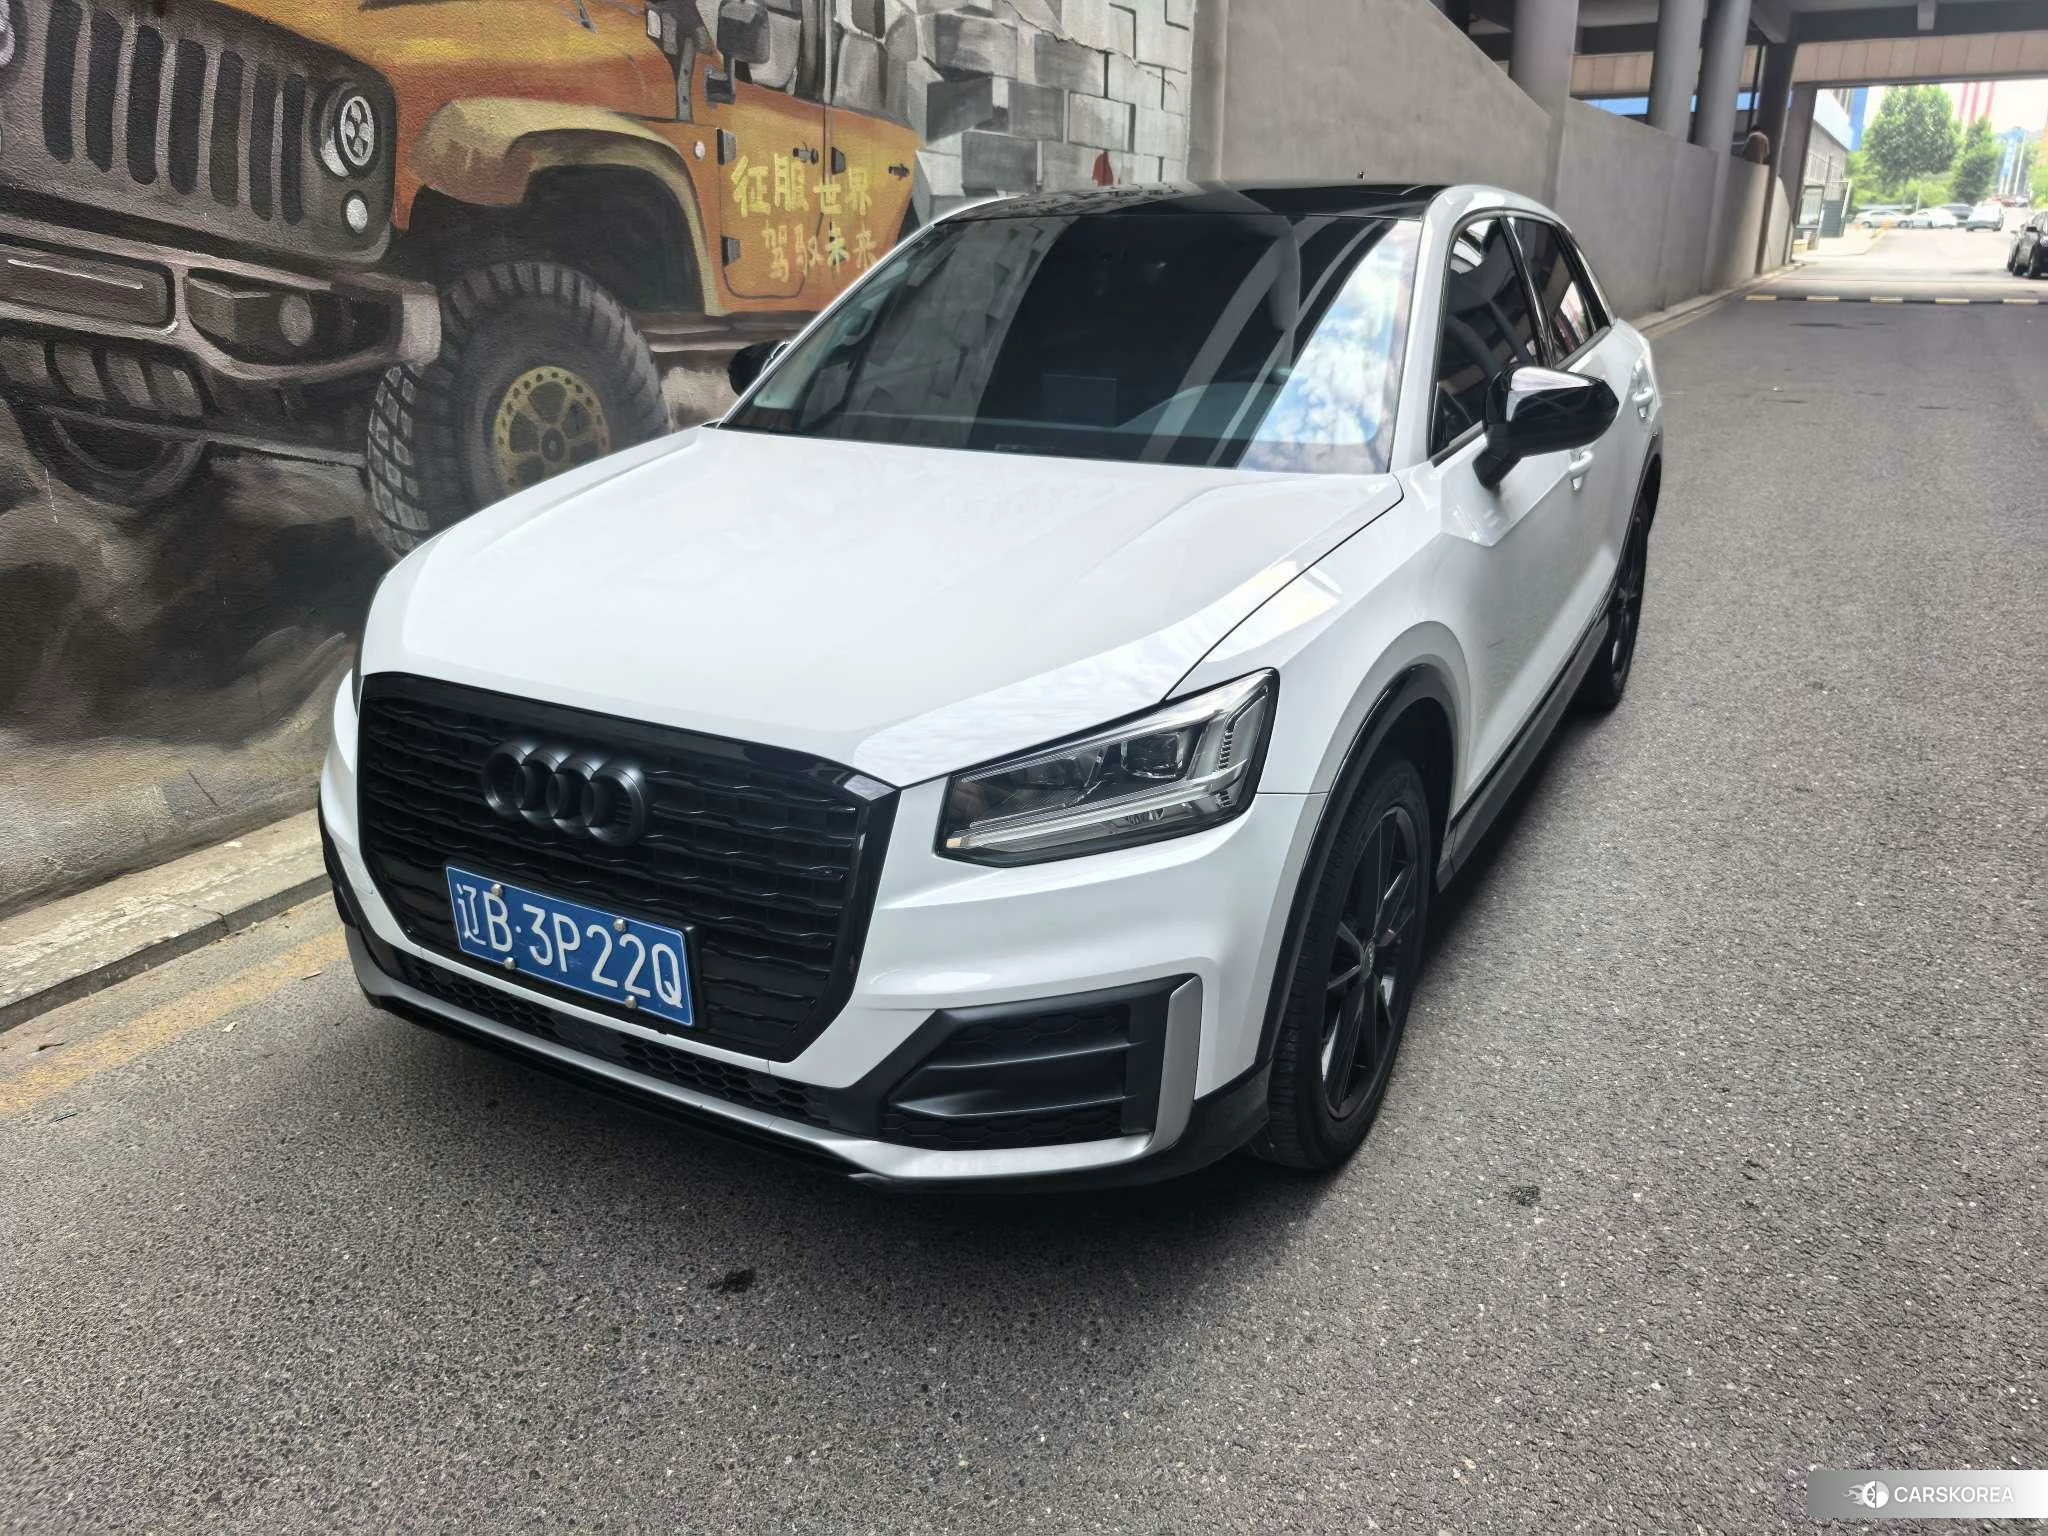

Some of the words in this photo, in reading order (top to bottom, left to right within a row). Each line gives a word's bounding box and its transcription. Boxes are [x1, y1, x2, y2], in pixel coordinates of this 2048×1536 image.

[731, 153, 872, 217] 征服世界
[761, 220, 877, 283] 驾驭未来
